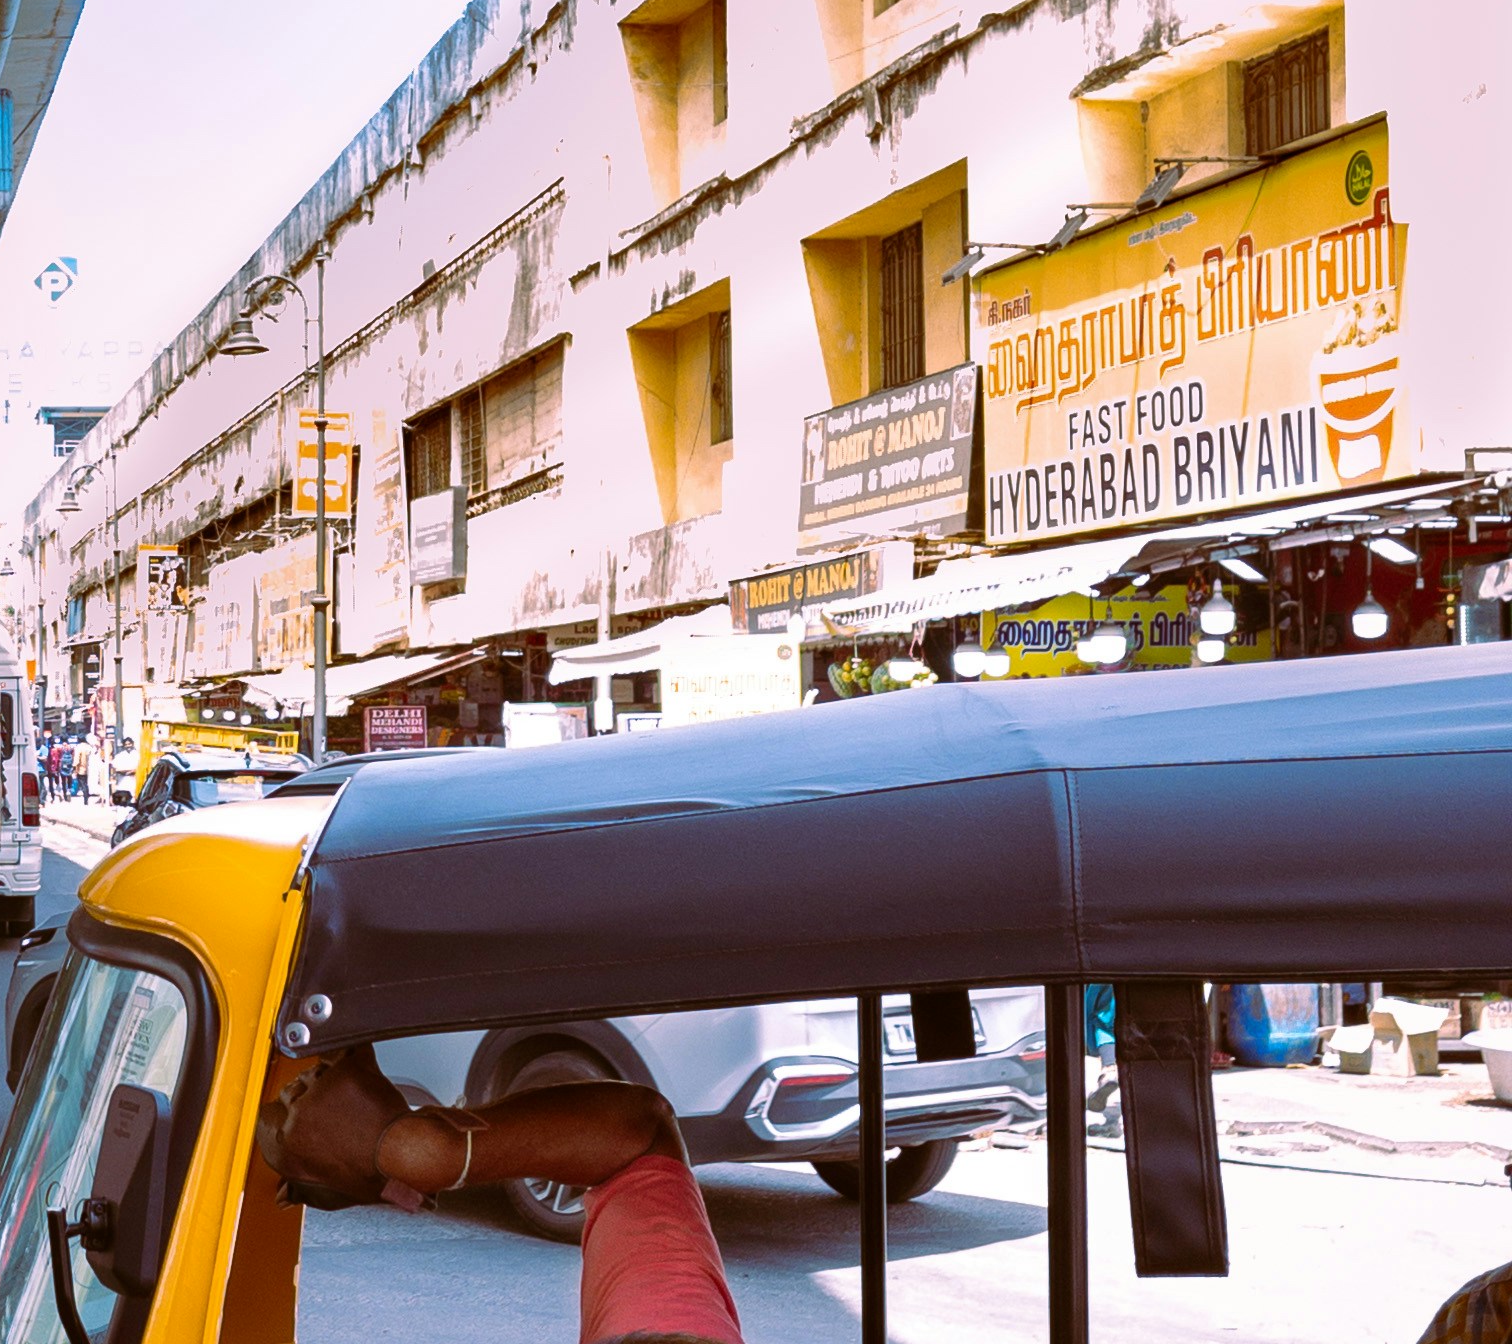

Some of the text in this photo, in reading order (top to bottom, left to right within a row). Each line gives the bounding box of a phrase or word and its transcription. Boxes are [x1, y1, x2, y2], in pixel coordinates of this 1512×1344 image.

[988, 187, 1396, 416] ஹைதராபாத் பிரியாணி
[827, 428, 873, 471] ROHIT
[888, 407, 947, 454] MANOJ
[1069, 382, 1204, 450] FAST FOOD
[989, 406, 1318, 537] HYDERABAD BRIYANI
[749, 575, 791, 609] ROHIT
[806, 559, 861, 597] MANOJ
[371, 718, 423, 726] MEHANDI
[371, 726, 424, 735] DESIGNERS
[372, 709, 421, 718] DELHI
